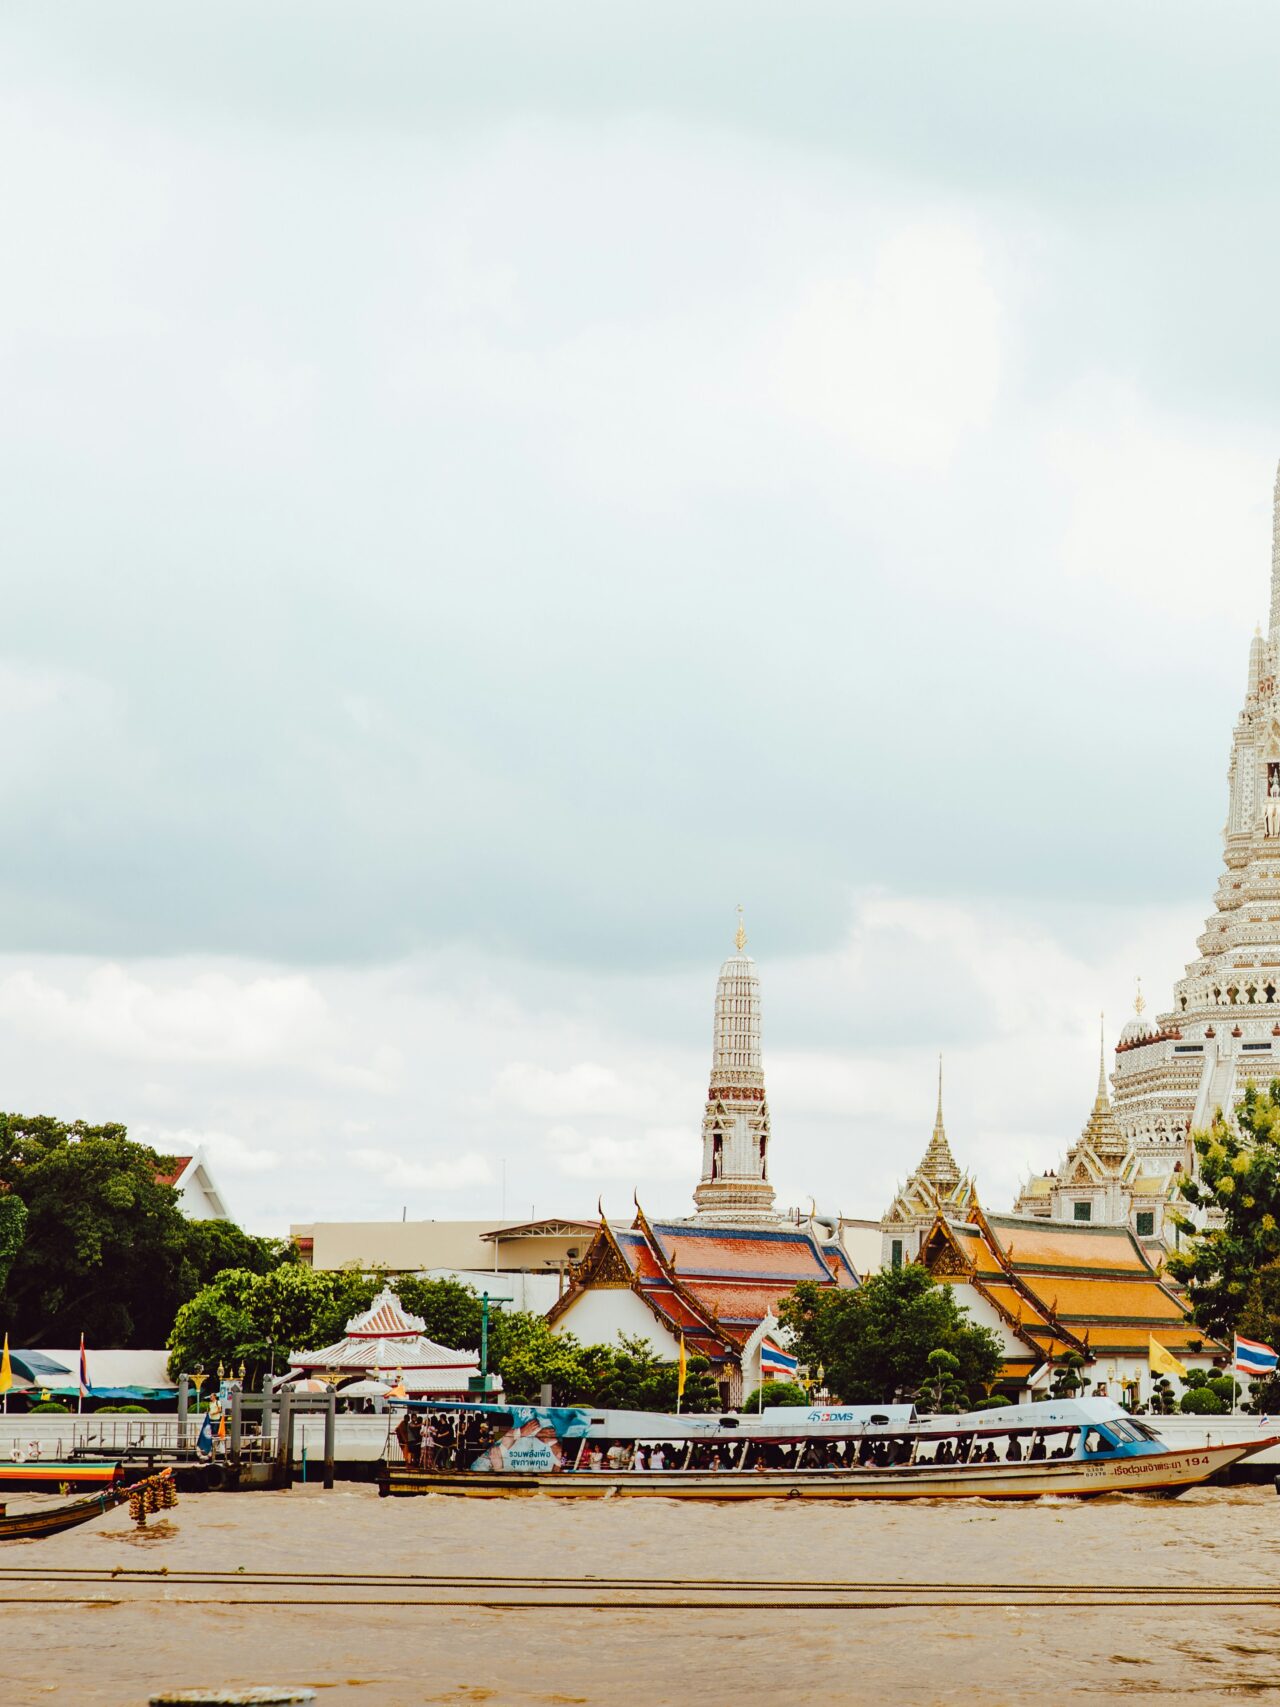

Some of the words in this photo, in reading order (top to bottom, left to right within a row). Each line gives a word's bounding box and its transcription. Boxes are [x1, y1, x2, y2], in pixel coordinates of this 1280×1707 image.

[511, 1458, 549, 1469] สุขภาพคุณ
[1114, 1461, 1182, 1476] เรือด่วนเจ้าพระยา
[1185, 1456, 1210, 1467] 194
